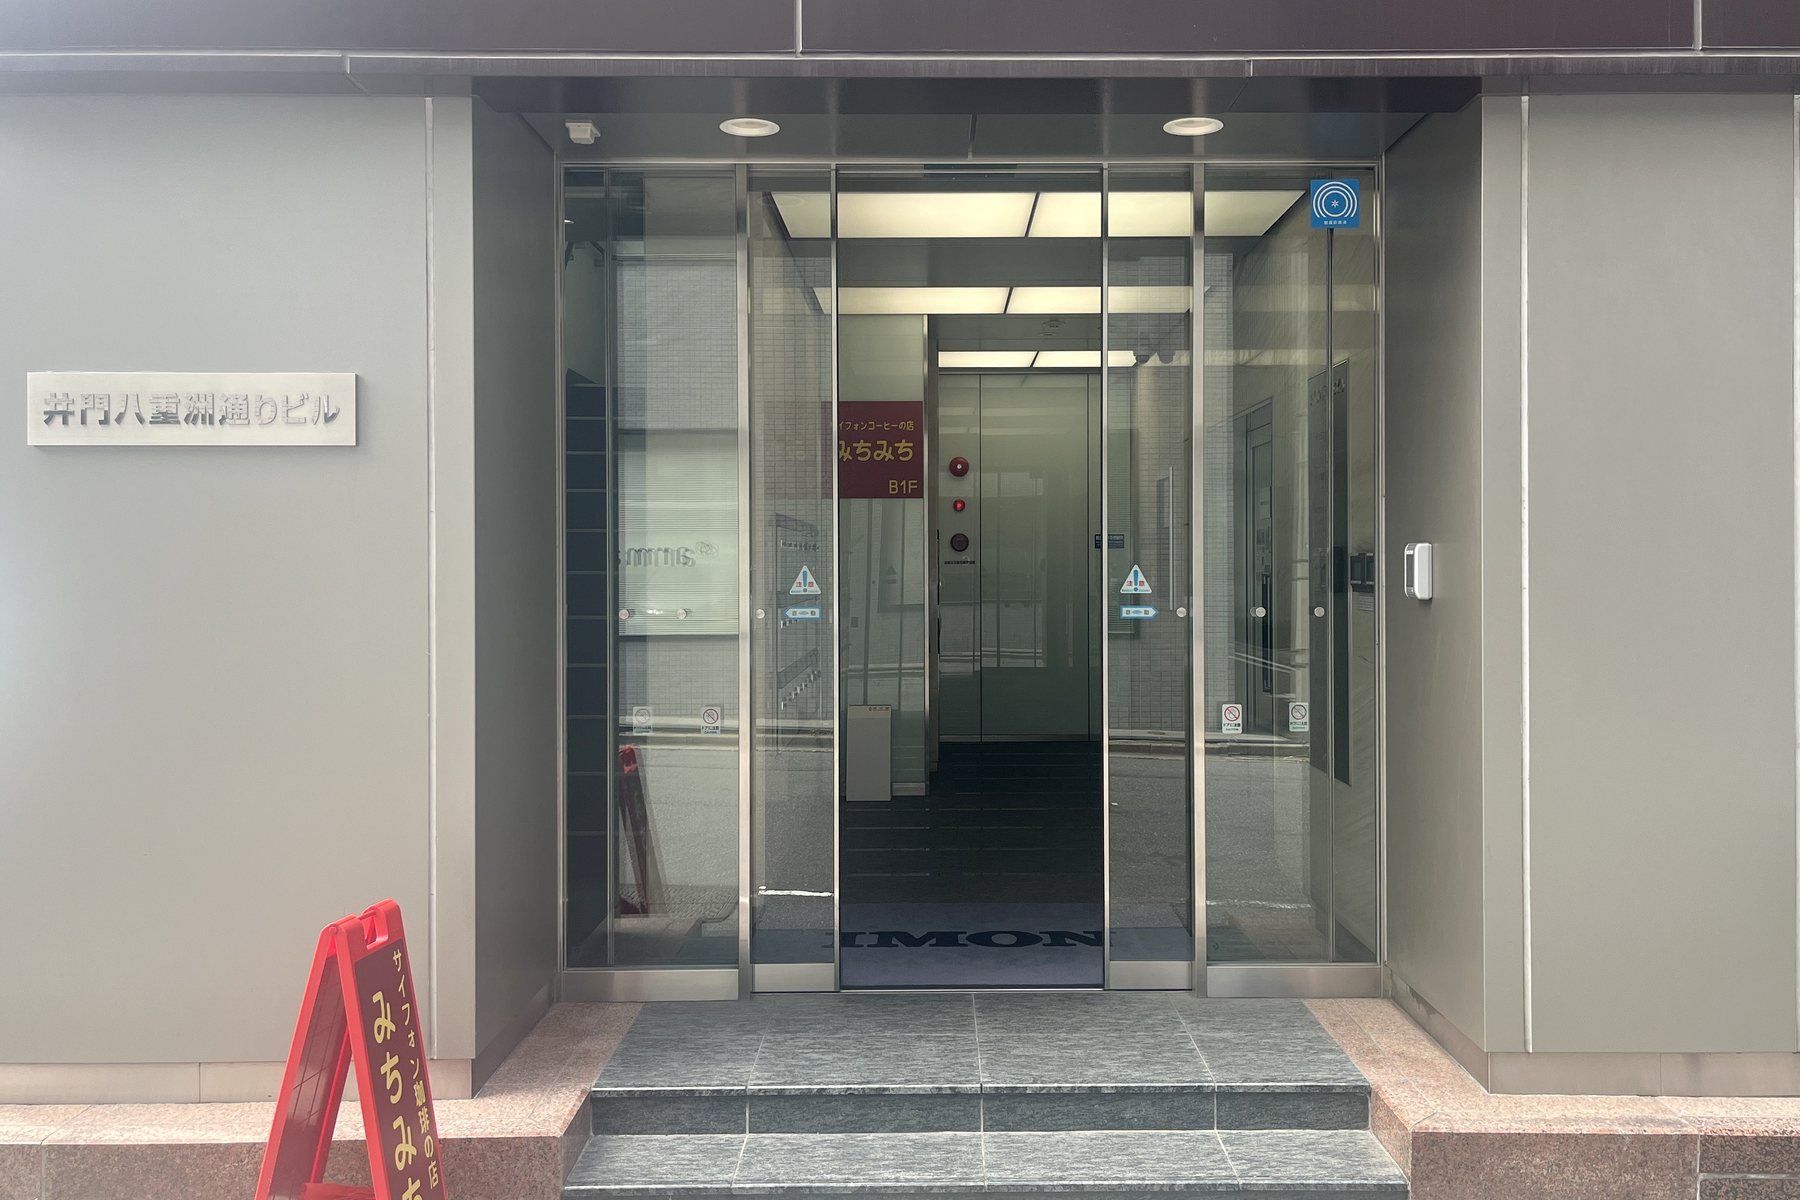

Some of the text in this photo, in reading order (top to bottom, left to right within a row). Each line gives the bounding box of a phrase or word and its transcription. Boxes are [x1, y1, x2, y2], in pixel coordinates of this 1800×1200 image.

[43, 392, 341, 425] 井門八重洲通りビル
[839, 421, 914, 431] イフォンコーヒーの店
[839, 439, 914, 462] みちみち
[888, 480, 918, 494] B1F
[822, 930, 1116, 948] IMON
[392, 949, 439, 1189] サイフォン珈琲の店
